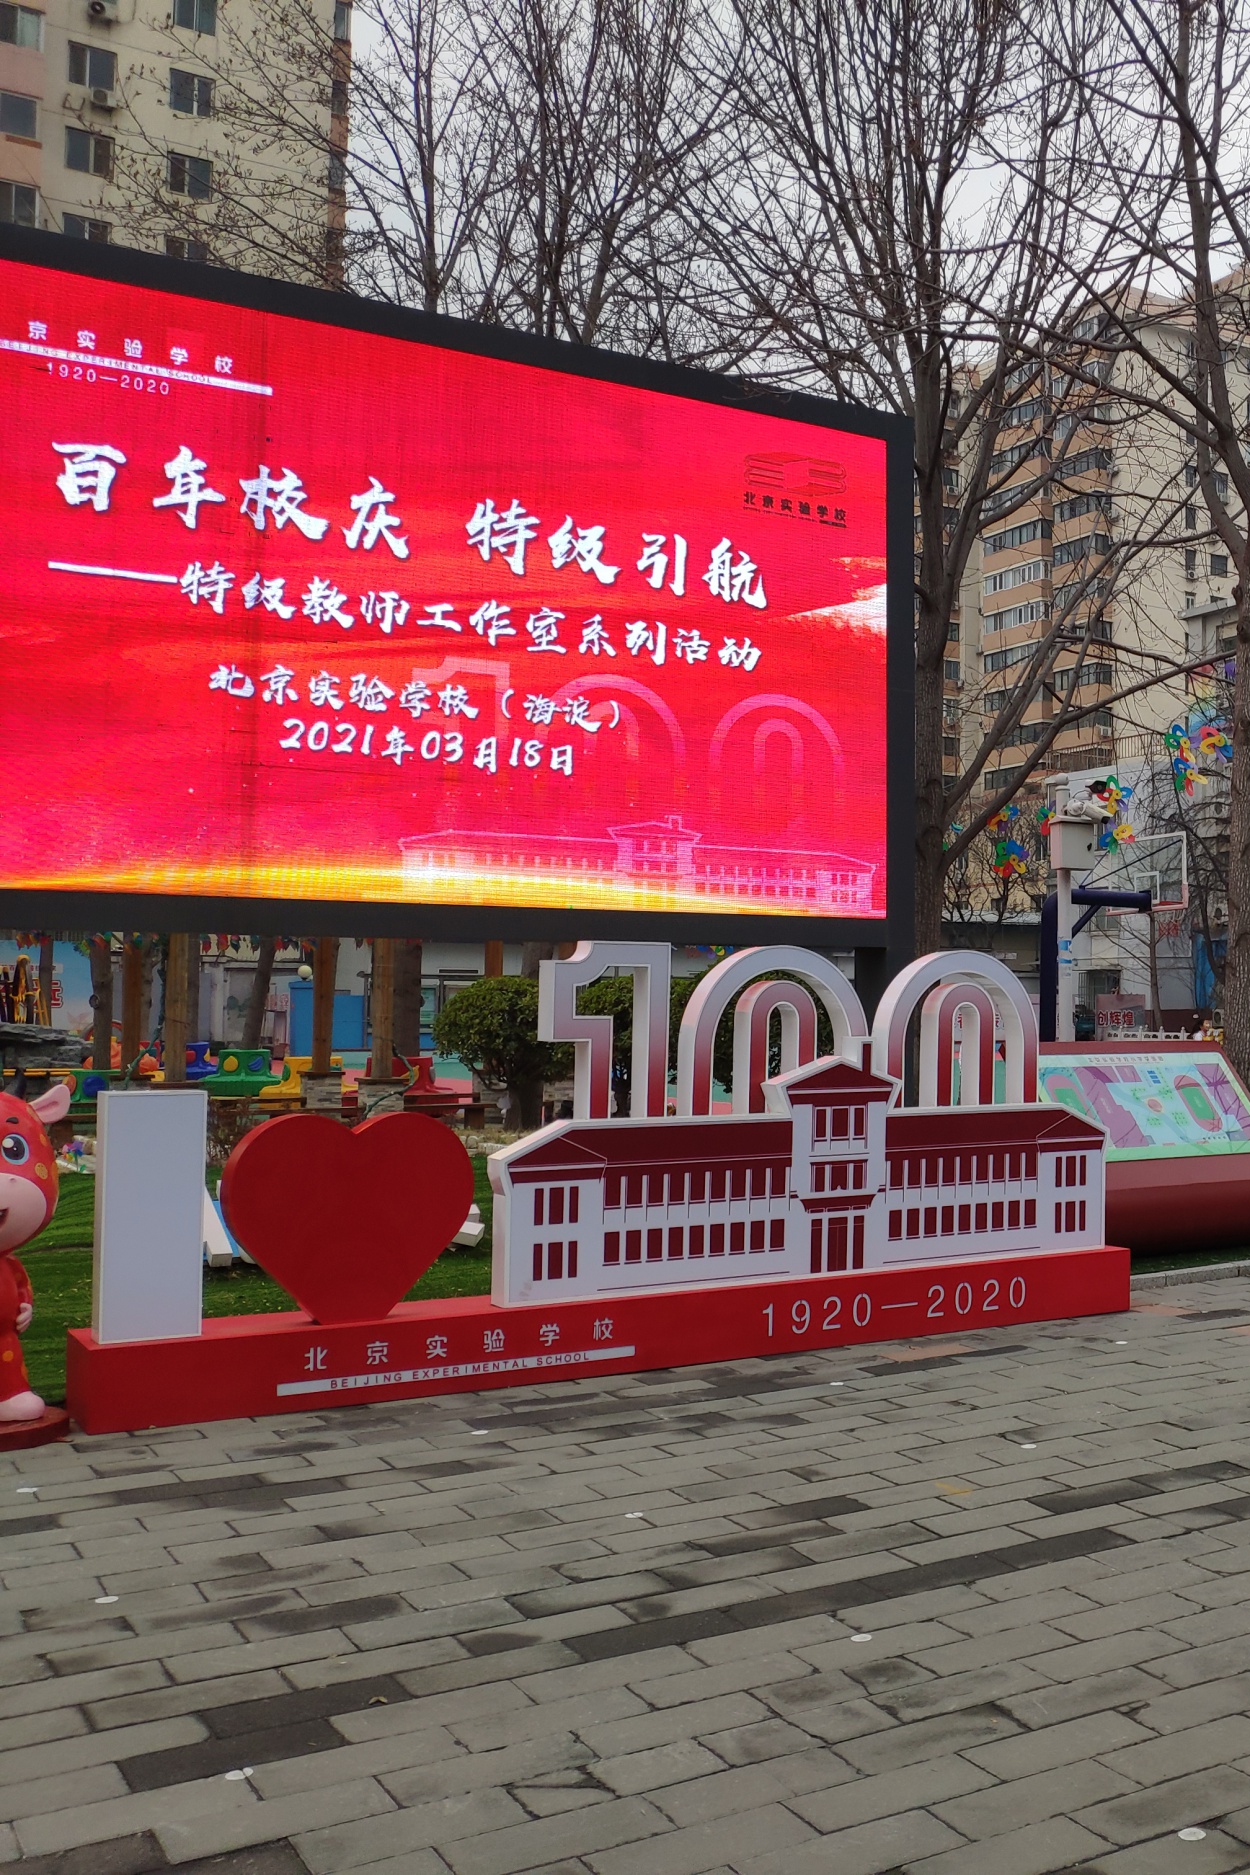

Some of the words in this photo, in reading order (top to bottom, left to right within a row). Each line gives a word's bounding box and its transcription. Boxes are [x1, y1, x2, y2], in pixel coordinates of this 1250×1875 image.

[28, 320, 233, 375] 京实验学校
[66, 351, 161, 376] EXPERIMENTAL
[167, 368, 212, 385] SCHOOL
[51, 441, 411, 560] 百年校庆
[465, 497, 768, 610] 特级引航
[279, 718, 575, 777] 2021年03月18日
[538, 940, 1039, 1119] 100
[304, 1317, 614, 1372] 北京实验学校
[330, 1372, 402, 1389] BEIJING
[411, 1359, 529, 1380] EXPERIMENTAL
[536, 1351, 590, 1367] SCHOOL
